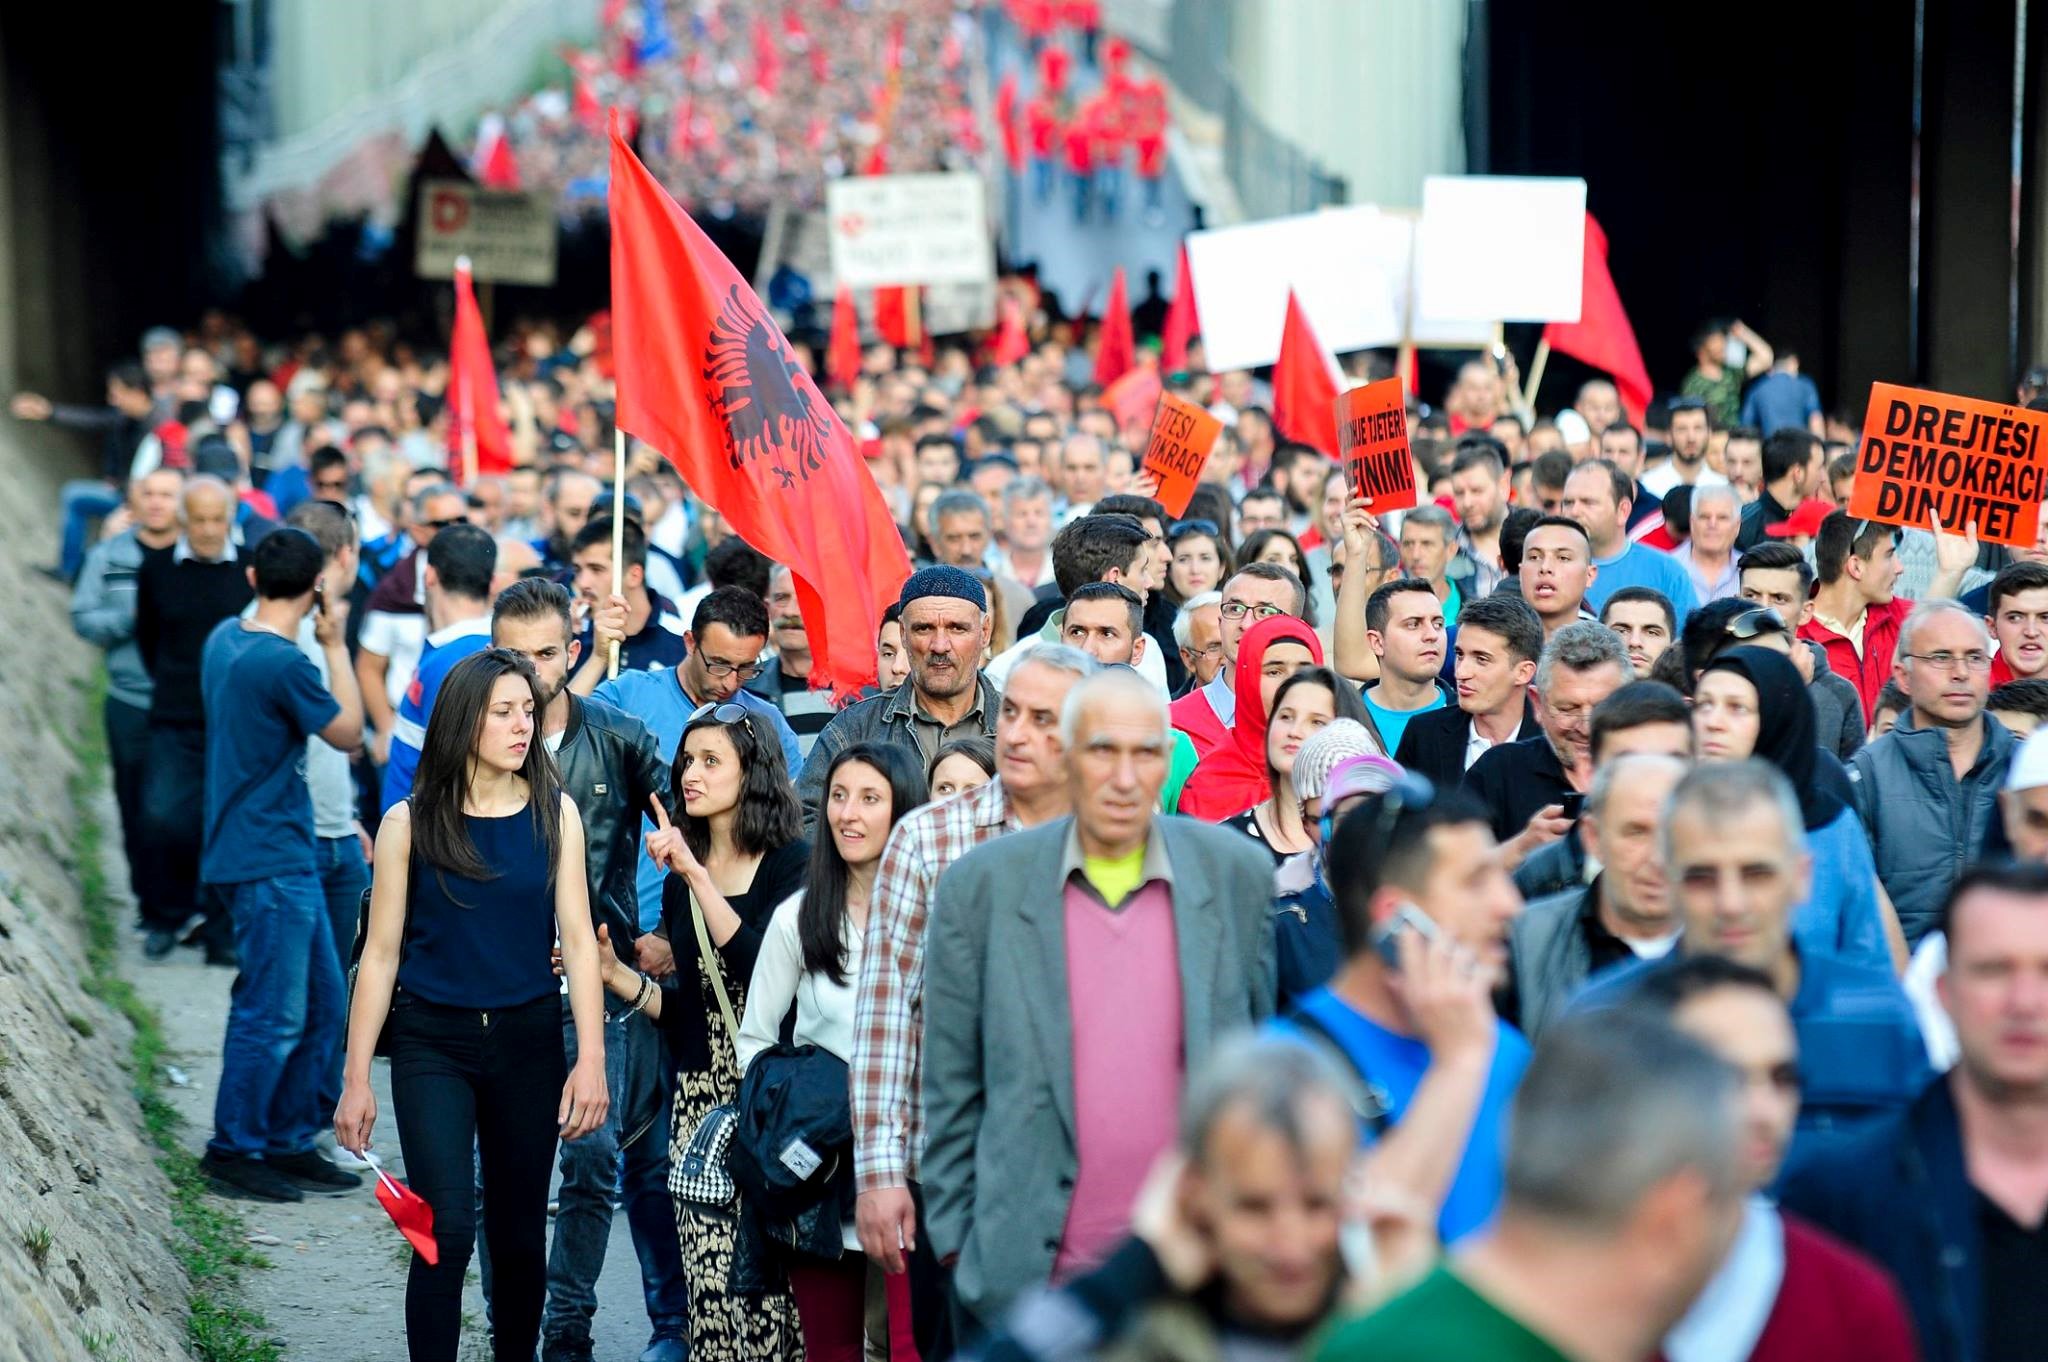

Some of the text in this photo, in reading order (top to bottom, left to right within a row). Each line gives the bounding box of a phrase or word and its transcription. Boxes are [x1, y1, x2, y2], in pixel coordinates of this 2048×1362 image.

[1885, 400, 2040, 461] DREJTËSI
[1862, 437, 2044, 503] DEMOKRACI
[1876, 481, 2021, 539] DINJITET
